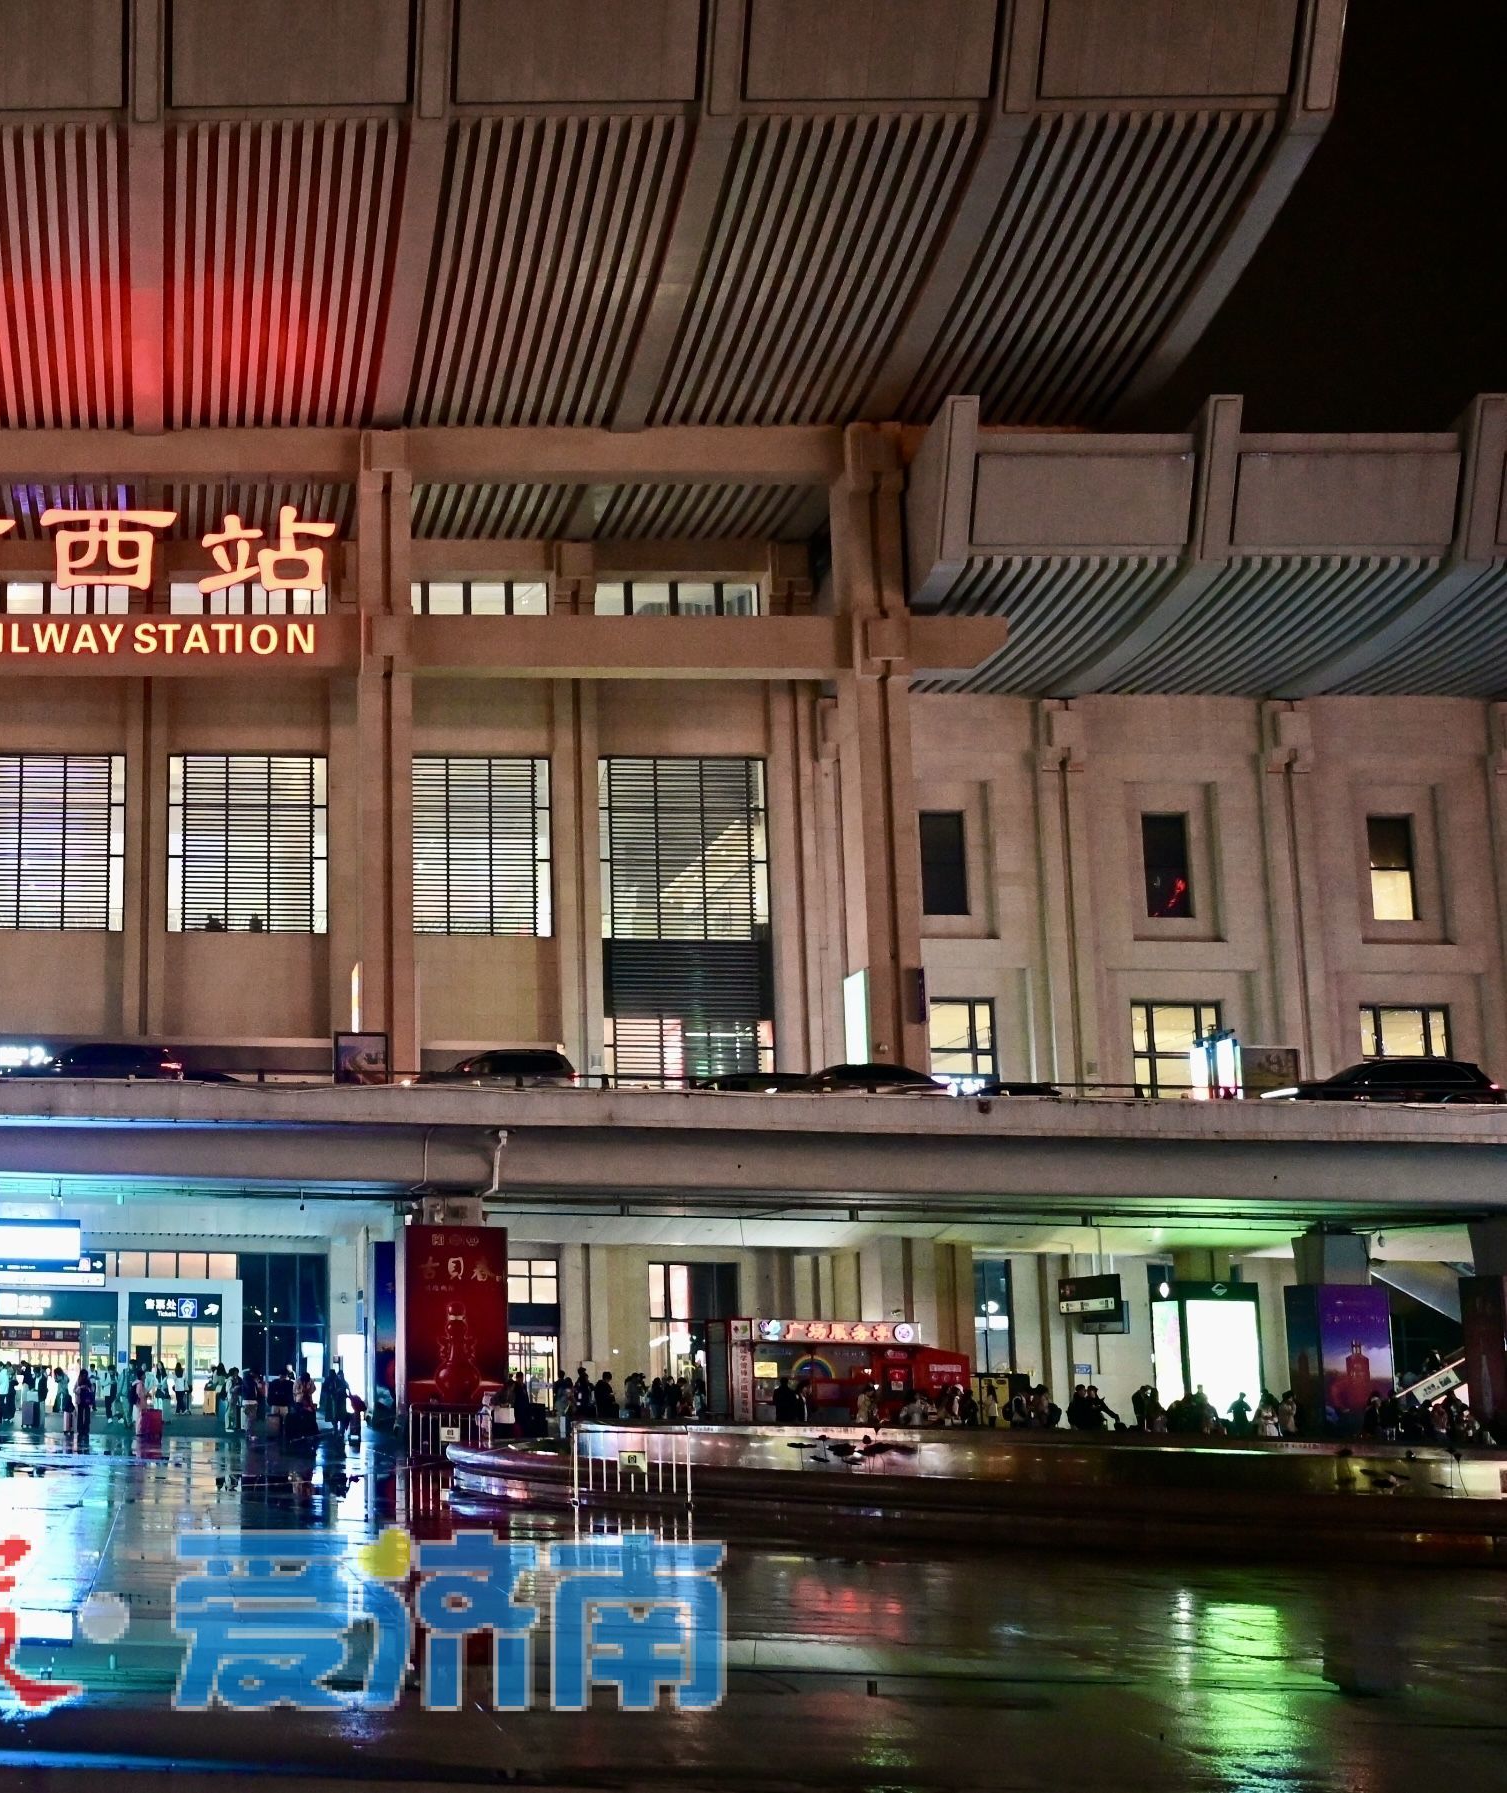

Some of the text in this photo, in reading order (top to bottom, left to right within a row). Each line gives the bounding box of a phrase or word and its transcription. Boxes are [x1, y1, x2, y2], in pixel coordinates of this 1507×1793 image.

[132, 622, 317, 655] STATION
[144, 1298, 177, 1310] 售票处
[784, 1321, 892, 1342] 广场服务亭
